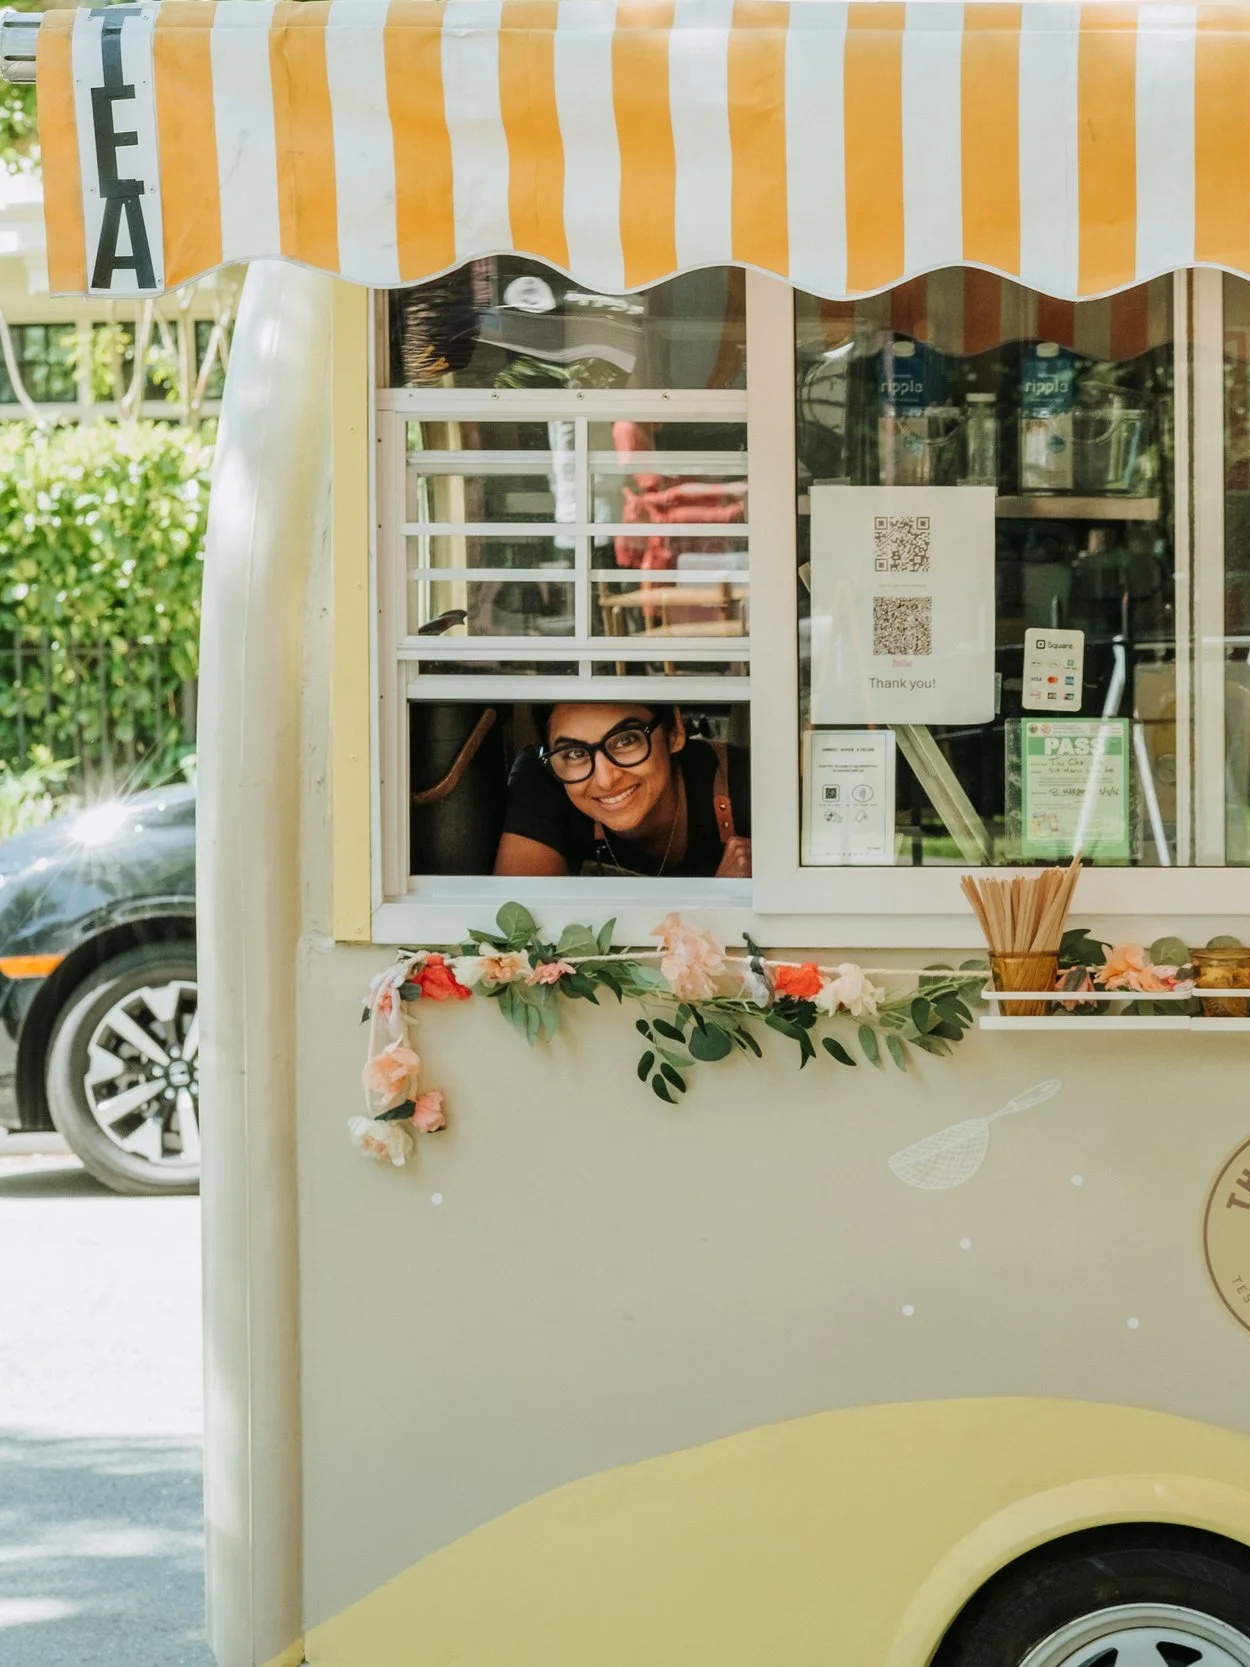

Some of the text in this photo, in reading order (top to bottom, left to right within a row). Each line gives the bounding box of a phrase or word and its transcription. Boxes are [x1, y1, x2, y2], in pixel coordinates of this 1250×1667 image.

[90, 8, 157, 289] TEA
[1024, 379, 1069, 395] ripple
[1047, 641, 1073, 651] Square
[868, 677, 936, 691] Thank you!
[1044, 737, 1105, 755] PASS
